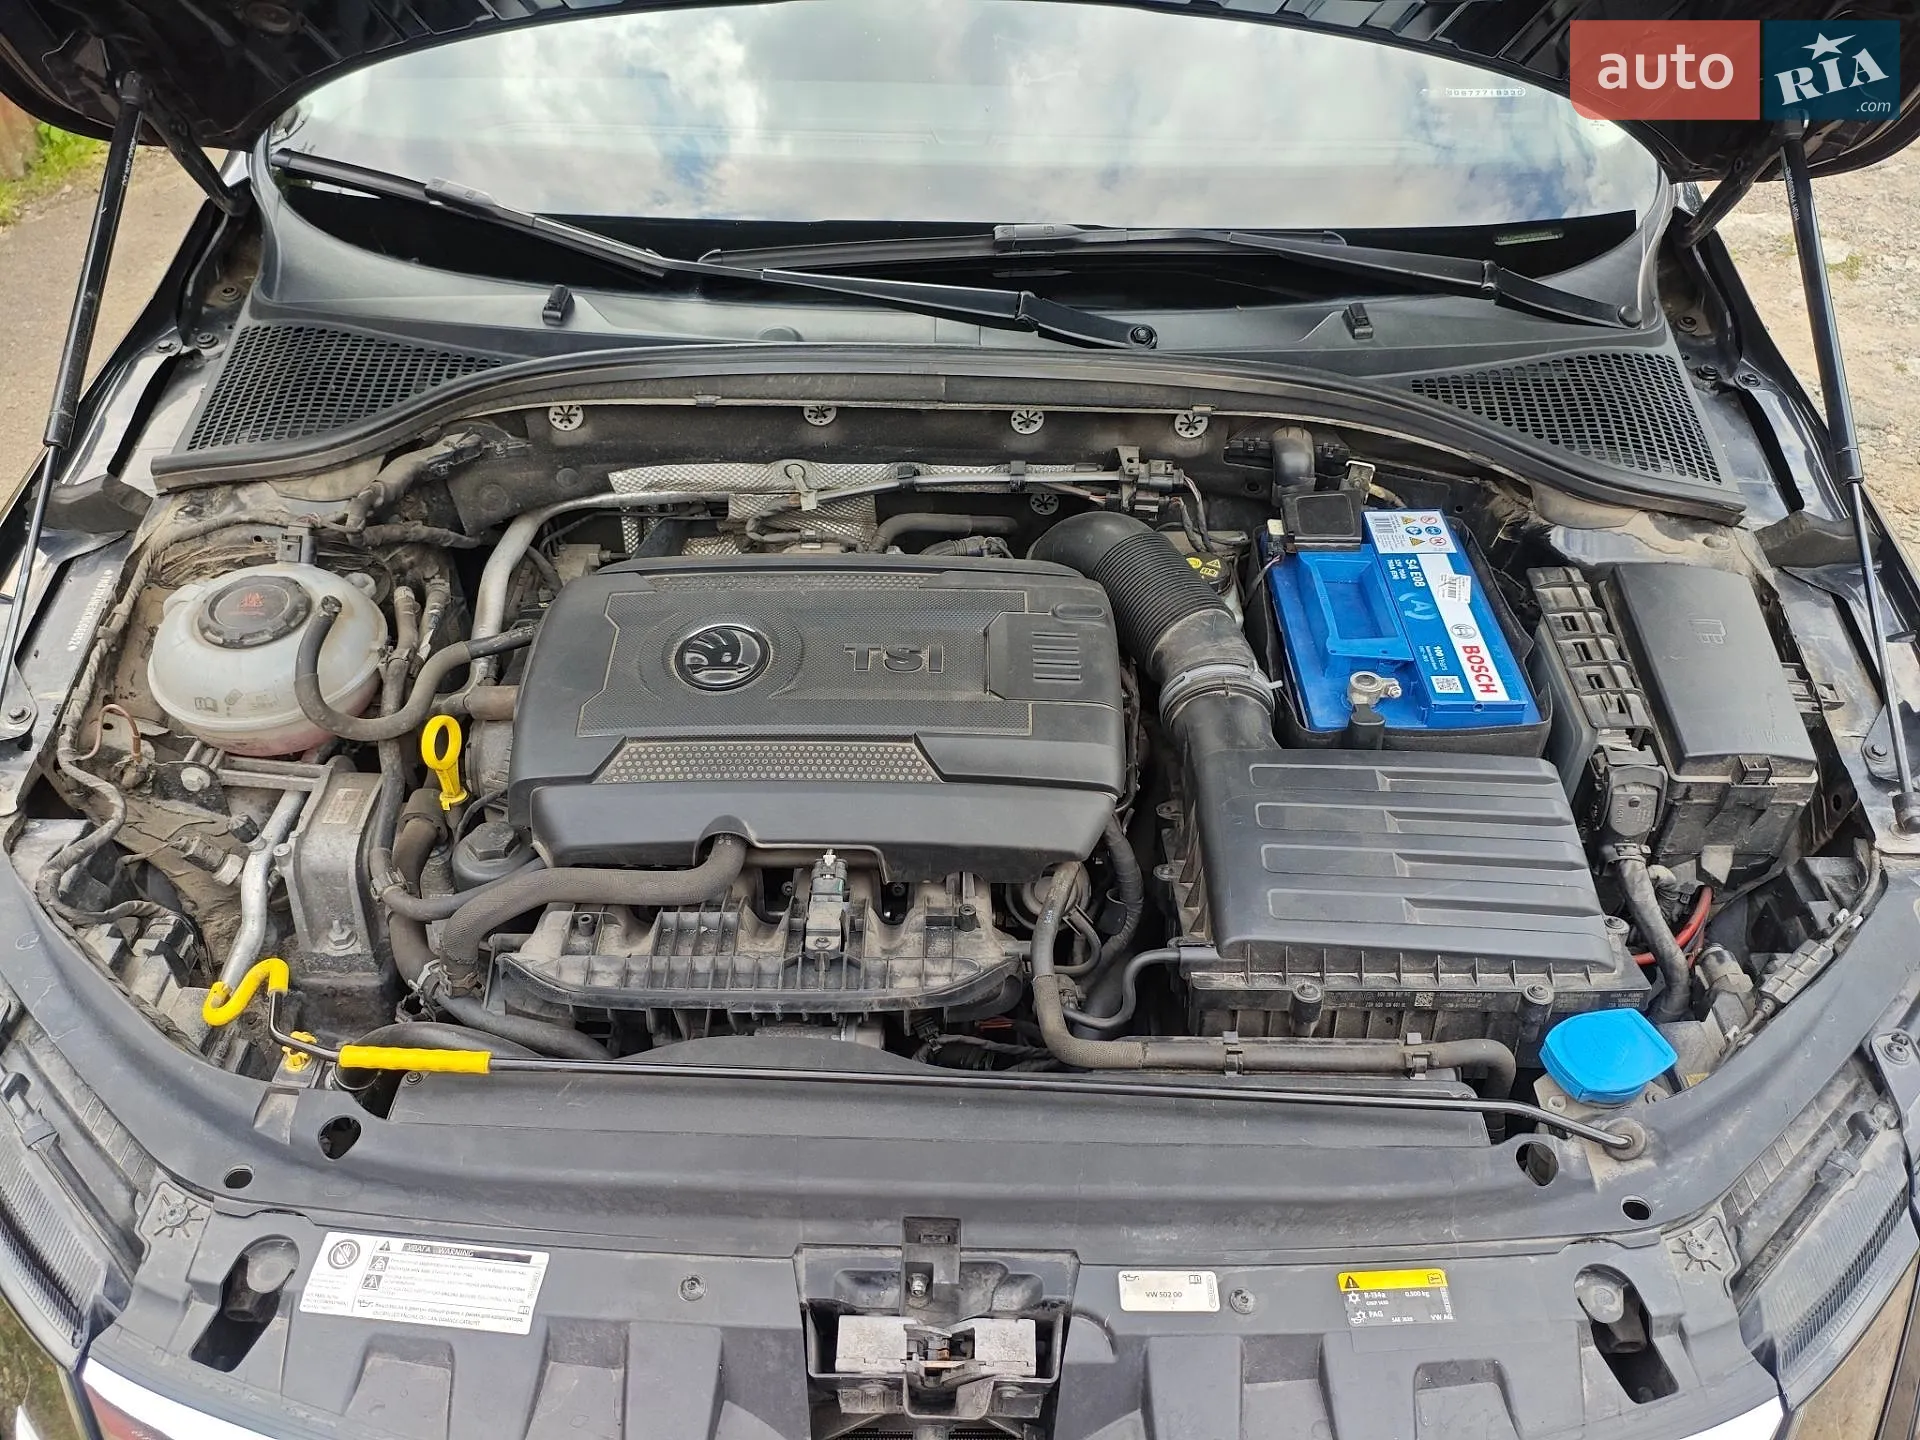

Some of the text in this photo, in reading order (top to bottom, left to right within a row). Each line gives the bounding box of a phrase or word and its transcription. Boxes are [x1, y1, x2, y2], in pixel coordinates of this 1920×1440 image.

[1405, 559, 1425, 587] S4 E08
[843, 643, 944, 673] TSI
[1433, 646, 1444, 657] 100
[1462, 645, 1498, 693] BOSCH
[439, 1247, 474, 1257] WARNING
[1369, 1310, 1384, 1318] PAG
